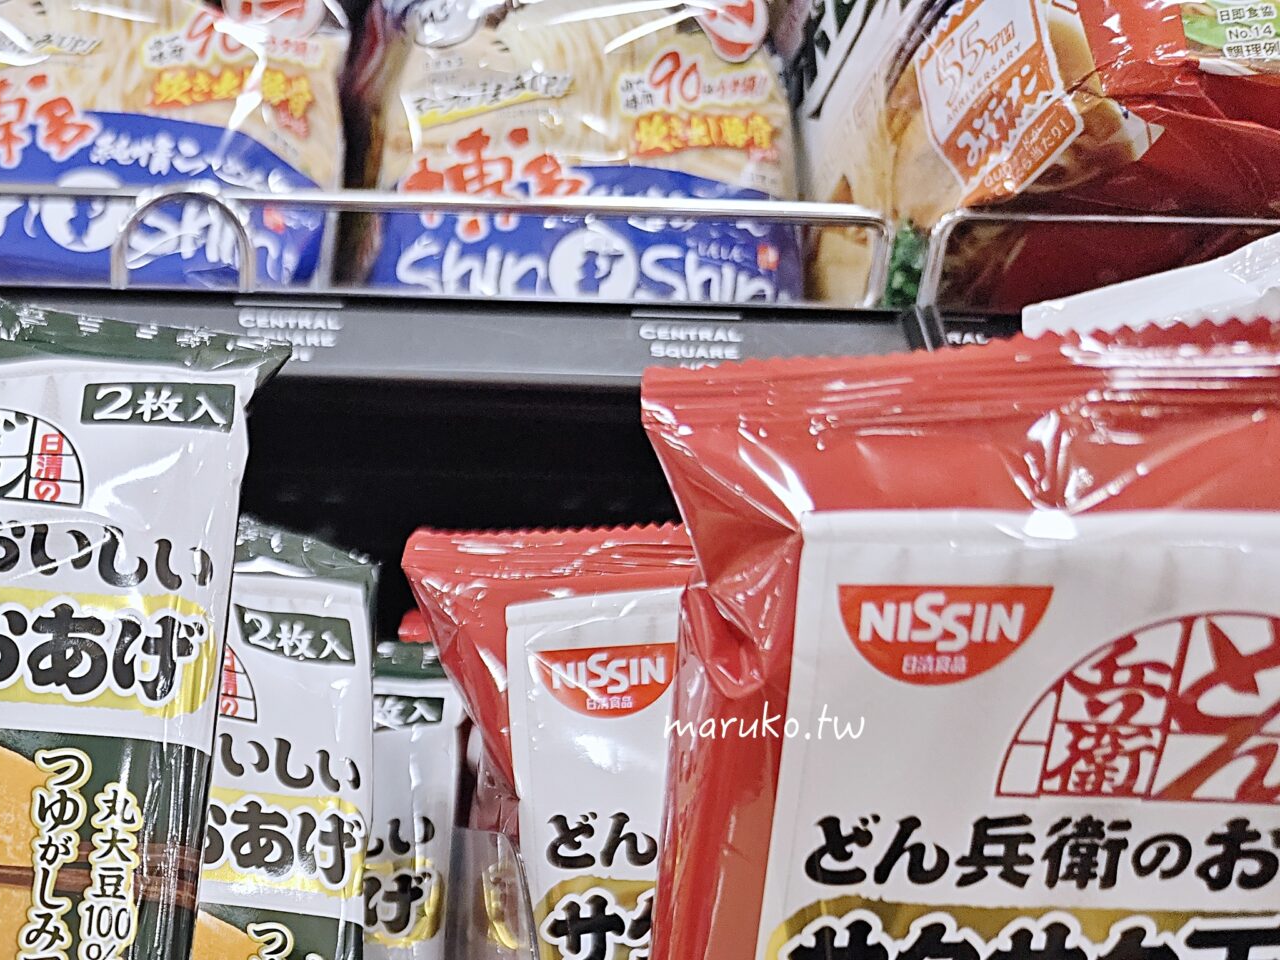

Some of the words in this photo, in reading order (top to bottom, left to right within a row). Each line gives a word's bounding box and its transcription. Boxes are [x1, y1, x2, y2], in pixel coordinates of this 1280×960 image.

[1228, 25, 1272, 40] No.14
[648, 50, 702, 105] 90
[238, 308, 343, 330] CENTRAL
[639, 323, 742, 343] CENTRAL
[650, 341, 740, 359] SQUARE
[90, 385, 228, 427] 2枚入
[34, 432, 65, 502] 日清の
[244, 606, 352, 662] 2枚入
[858, 591, 1025, 653] NISSIN
[550, 652, 667, 694] NISSIN
[901, 656, 968, 675] 日清食品
[585, 695, 633, 710] 日清食品
[546, 811, 658, 870] どん
[803, 813, 1280, 892] どん兵衛のお
